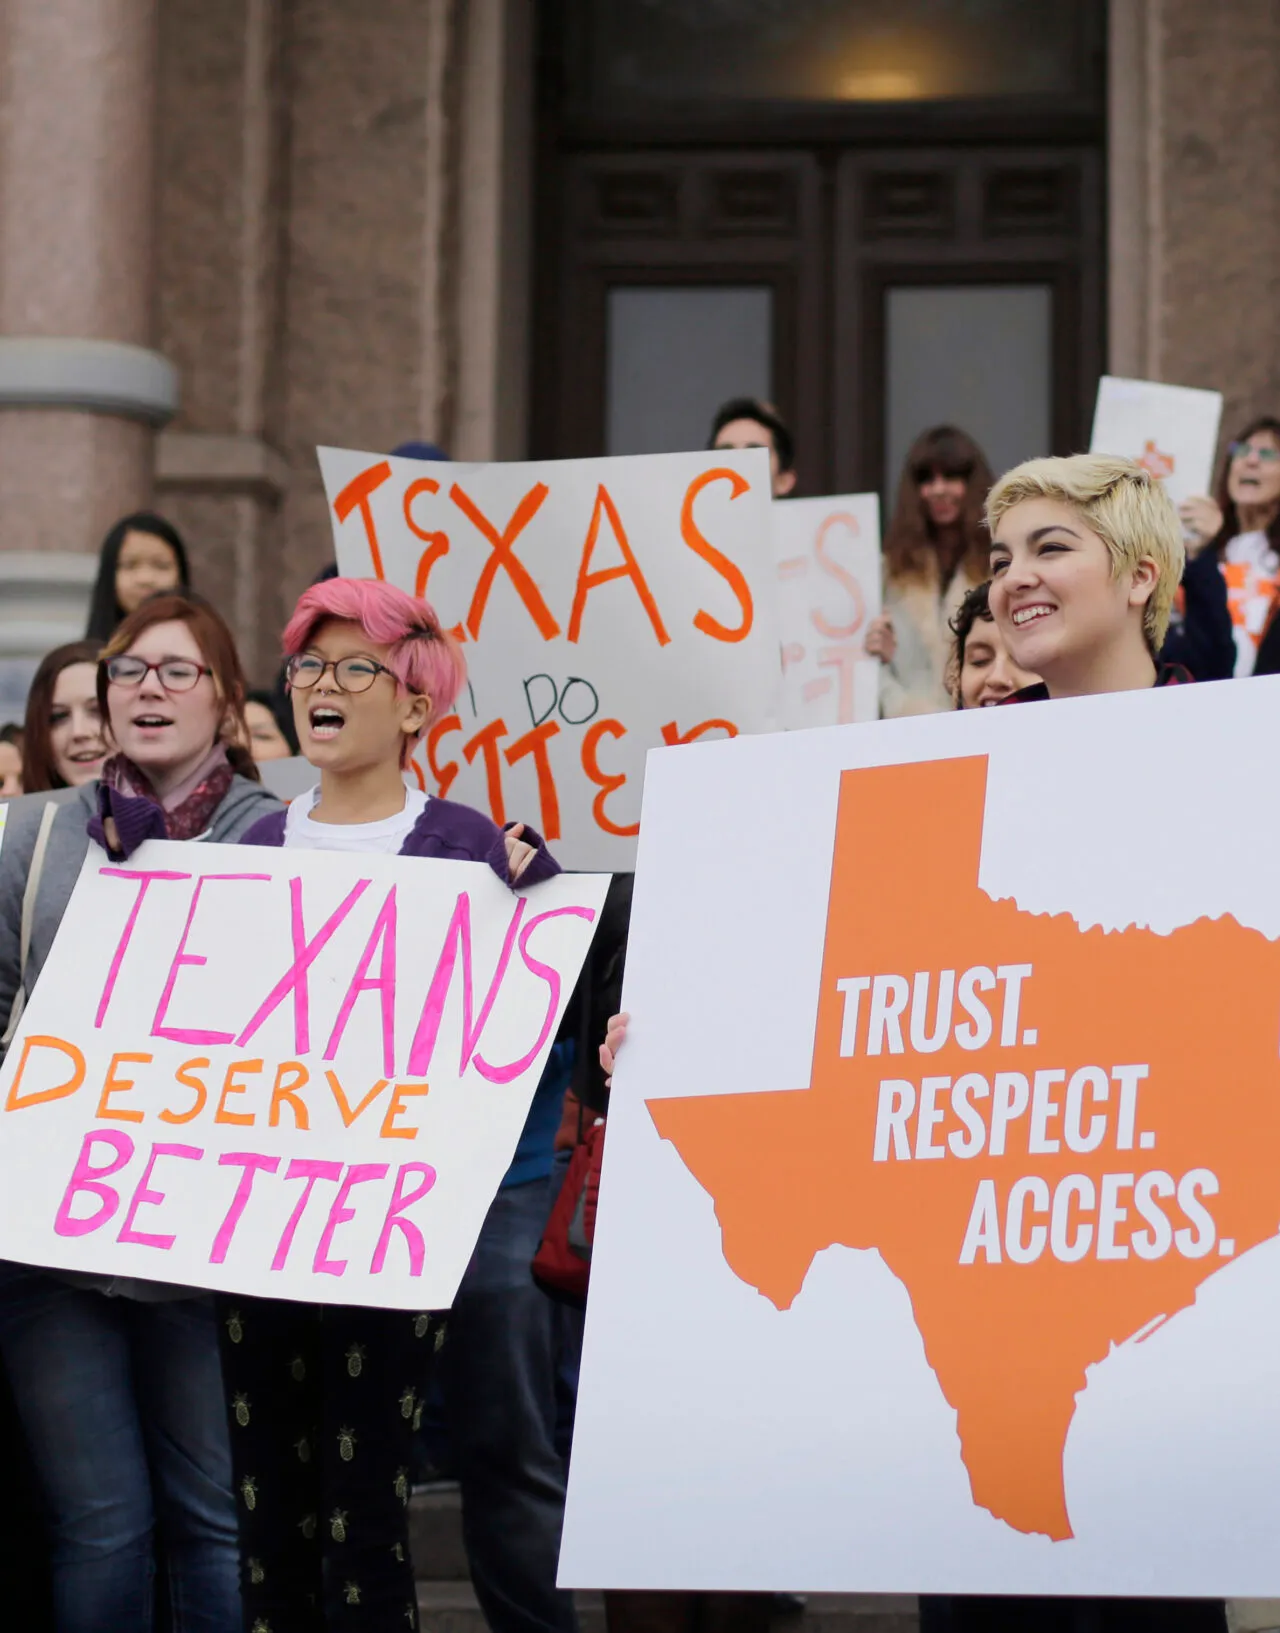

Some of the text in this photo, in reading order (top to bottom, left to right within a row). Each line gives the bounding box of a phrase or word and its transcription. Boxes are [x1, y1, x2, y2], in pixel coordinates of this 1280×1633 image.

[334, 460, 754, 647] TEXAS
[523, 673, 599, 728] DO
[408, 714, 738, 841] ETTE
[94, 867, 596, 1085] TEXANS
[836, 963, 1039, 1058] TRUST.
[4, 1035, 429, 1140] DESERVE
[872, 1063, 1156, 1162] RESPECT.
[53, 1129, 438, 1277] BETTER
[958, 1168, 1236, 1265] ACCESS.
